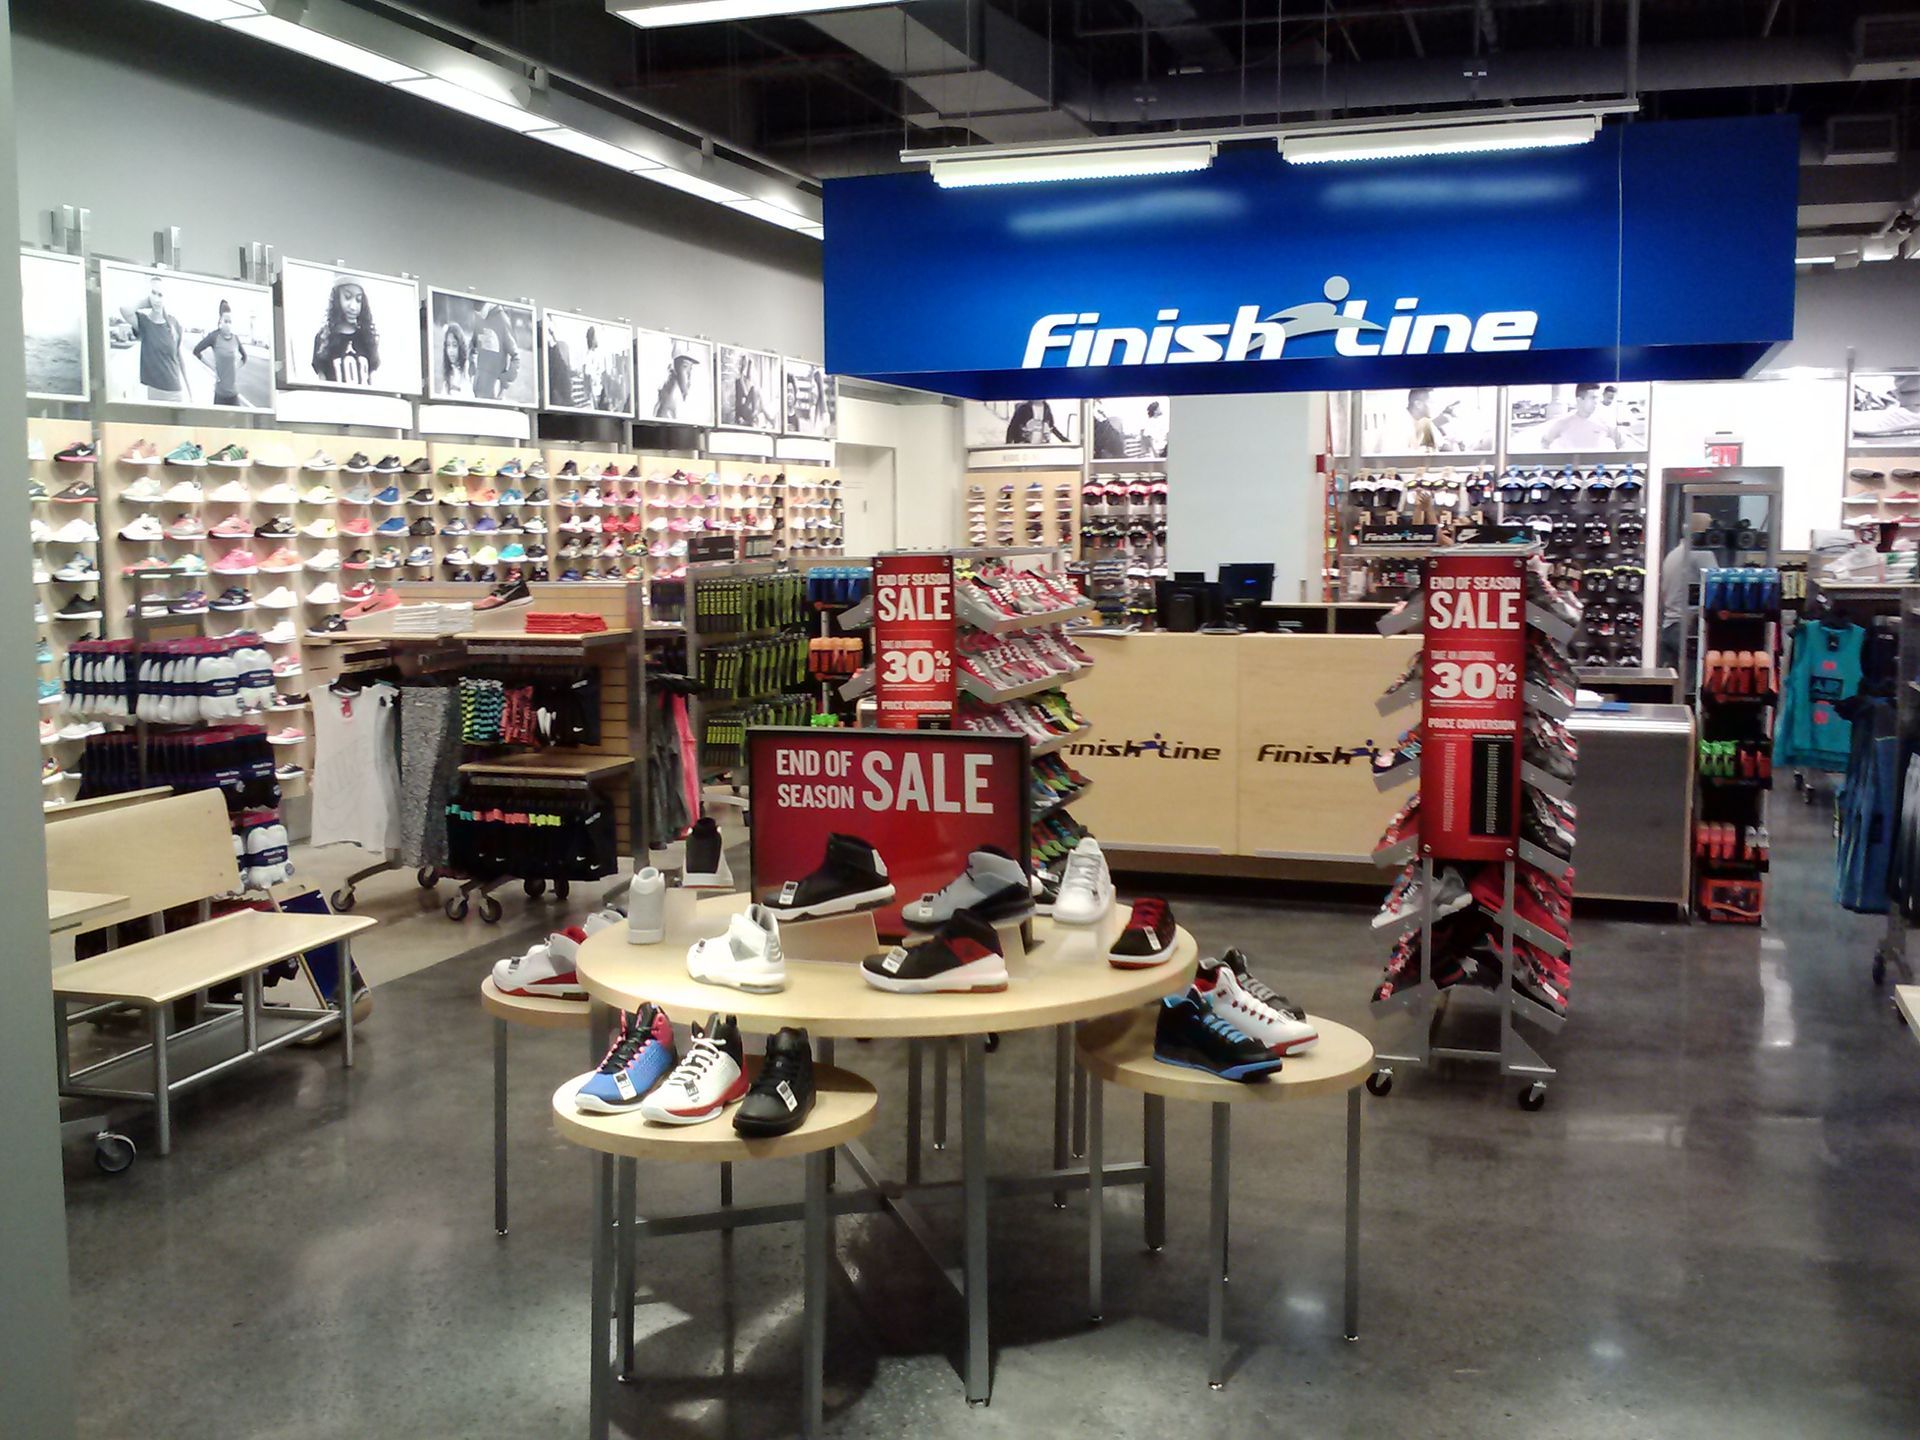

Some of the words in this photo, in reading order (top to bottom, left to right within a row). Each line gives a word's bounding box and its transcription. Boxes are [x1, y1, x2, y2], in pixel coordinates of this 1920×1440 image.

[1021, 304, 1287, 368] Finish
[1334, 297, 1539, 357] Line
[876, 574, 897, 586] END
[1429, 576, 1455, 590] END
[1455, 576, 1473, 590] OF
[1472, 576, 1521, 590] SEASON
[877, 586, 952, 622] SALE
[1429, 591, 1521, 630] SALE
[934, 668, 952, 683] OFF
[1495, 683, 1517, 699] OFF
[776, 749, 820, 777] END
[824, 750, 854, 777] OF
[1256, 744, 1352, 766] Finish
[861, 749, 994, 815] SALE
[777, 783, 855, 810] SEASON
